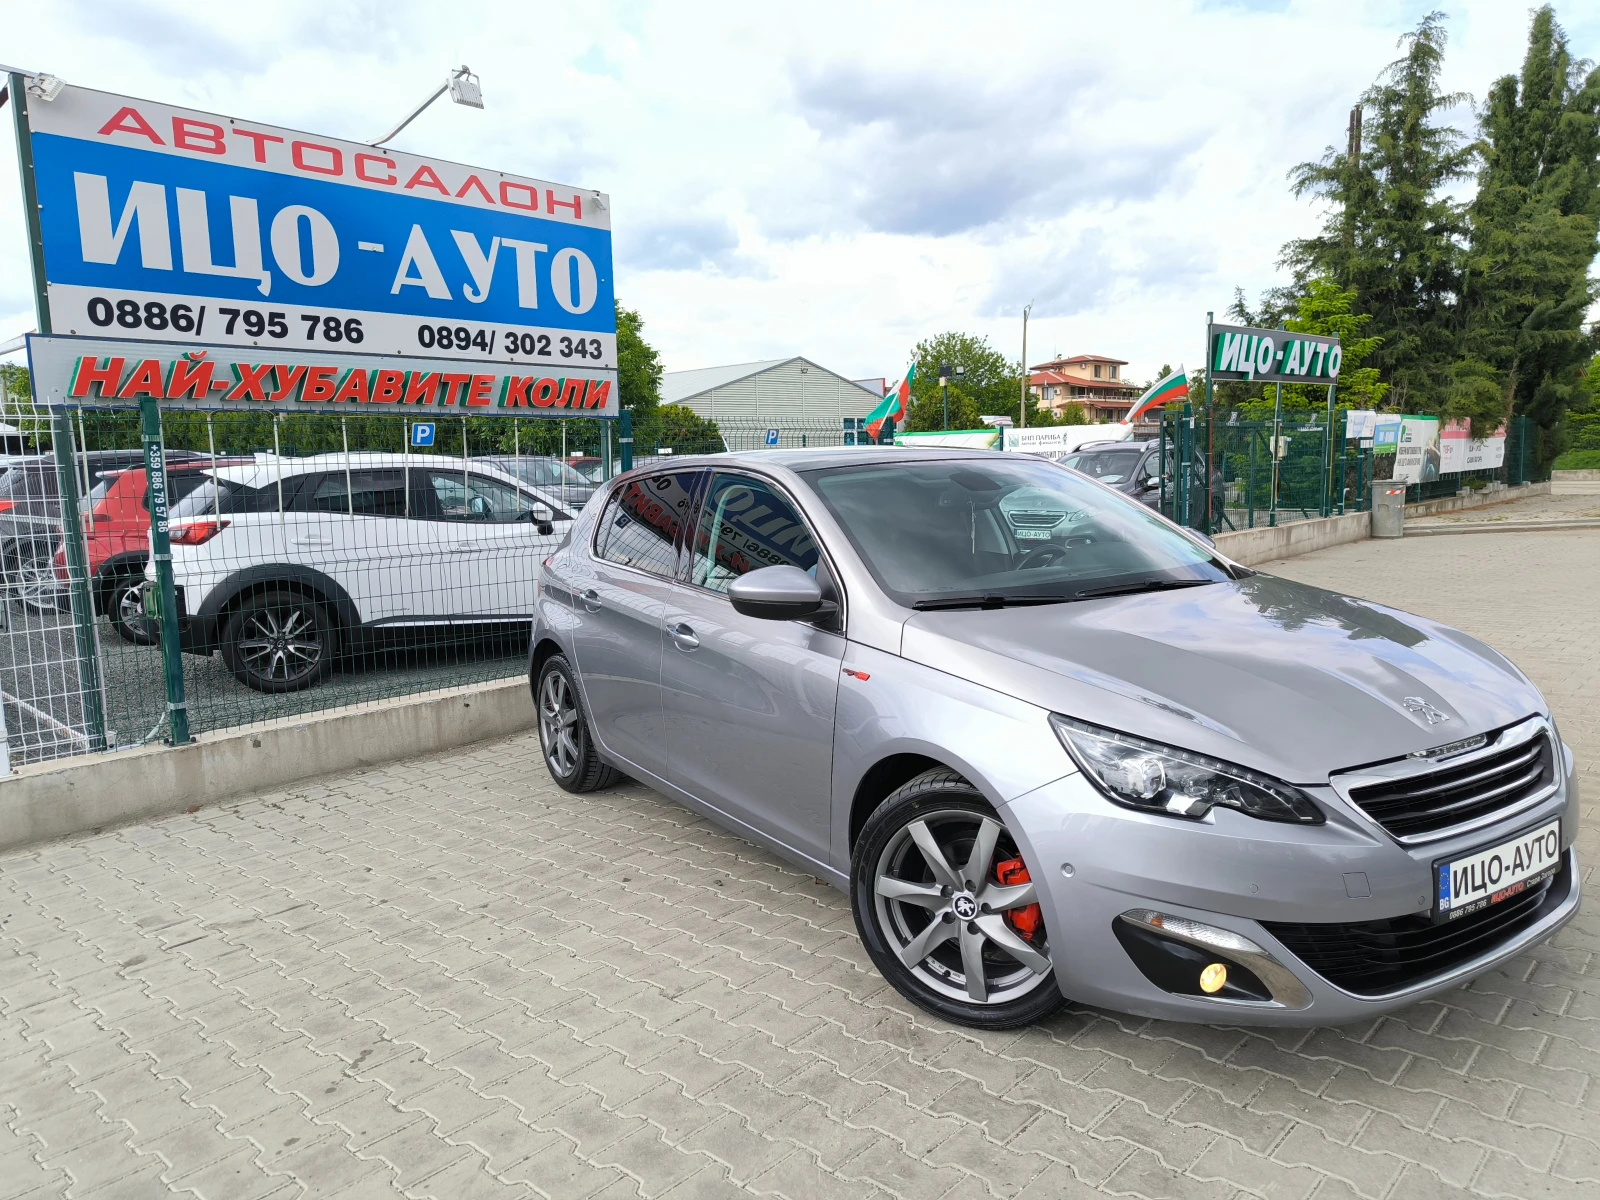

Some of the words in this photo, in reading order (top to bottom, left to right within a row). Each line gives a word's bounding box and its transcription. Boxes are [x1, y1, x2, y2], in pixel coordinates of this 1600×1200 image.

[97, 106, 582, 219] АВТОСАЛОН
[87, 297, 206, 336] 0886/
[219, 307, 289, 338] 795
[300, 314, 364, 344] 786
[417, 324, 496, 355] 0894/
[504, 331, 552, 357] 302
[559, 336, 603, 360] 343
[1218, 332, 1342, 380] ИЦО-АУТО
[69, 350, 495, 407] НАЙ-ХУБАВИТЕ
[498, 375, 612, 409] КОЛИ
[150, 444, 162, 469] +359
[151, 471, 163, 490] 886
[153, 491, 165, 504] 79
[155, 506, 167, 518] 57
[157, 520, 169, 533] 86
[1453, 829, 1557, 899] ИЦО-АУТО
[1439, 896, 1450, 911] BG
